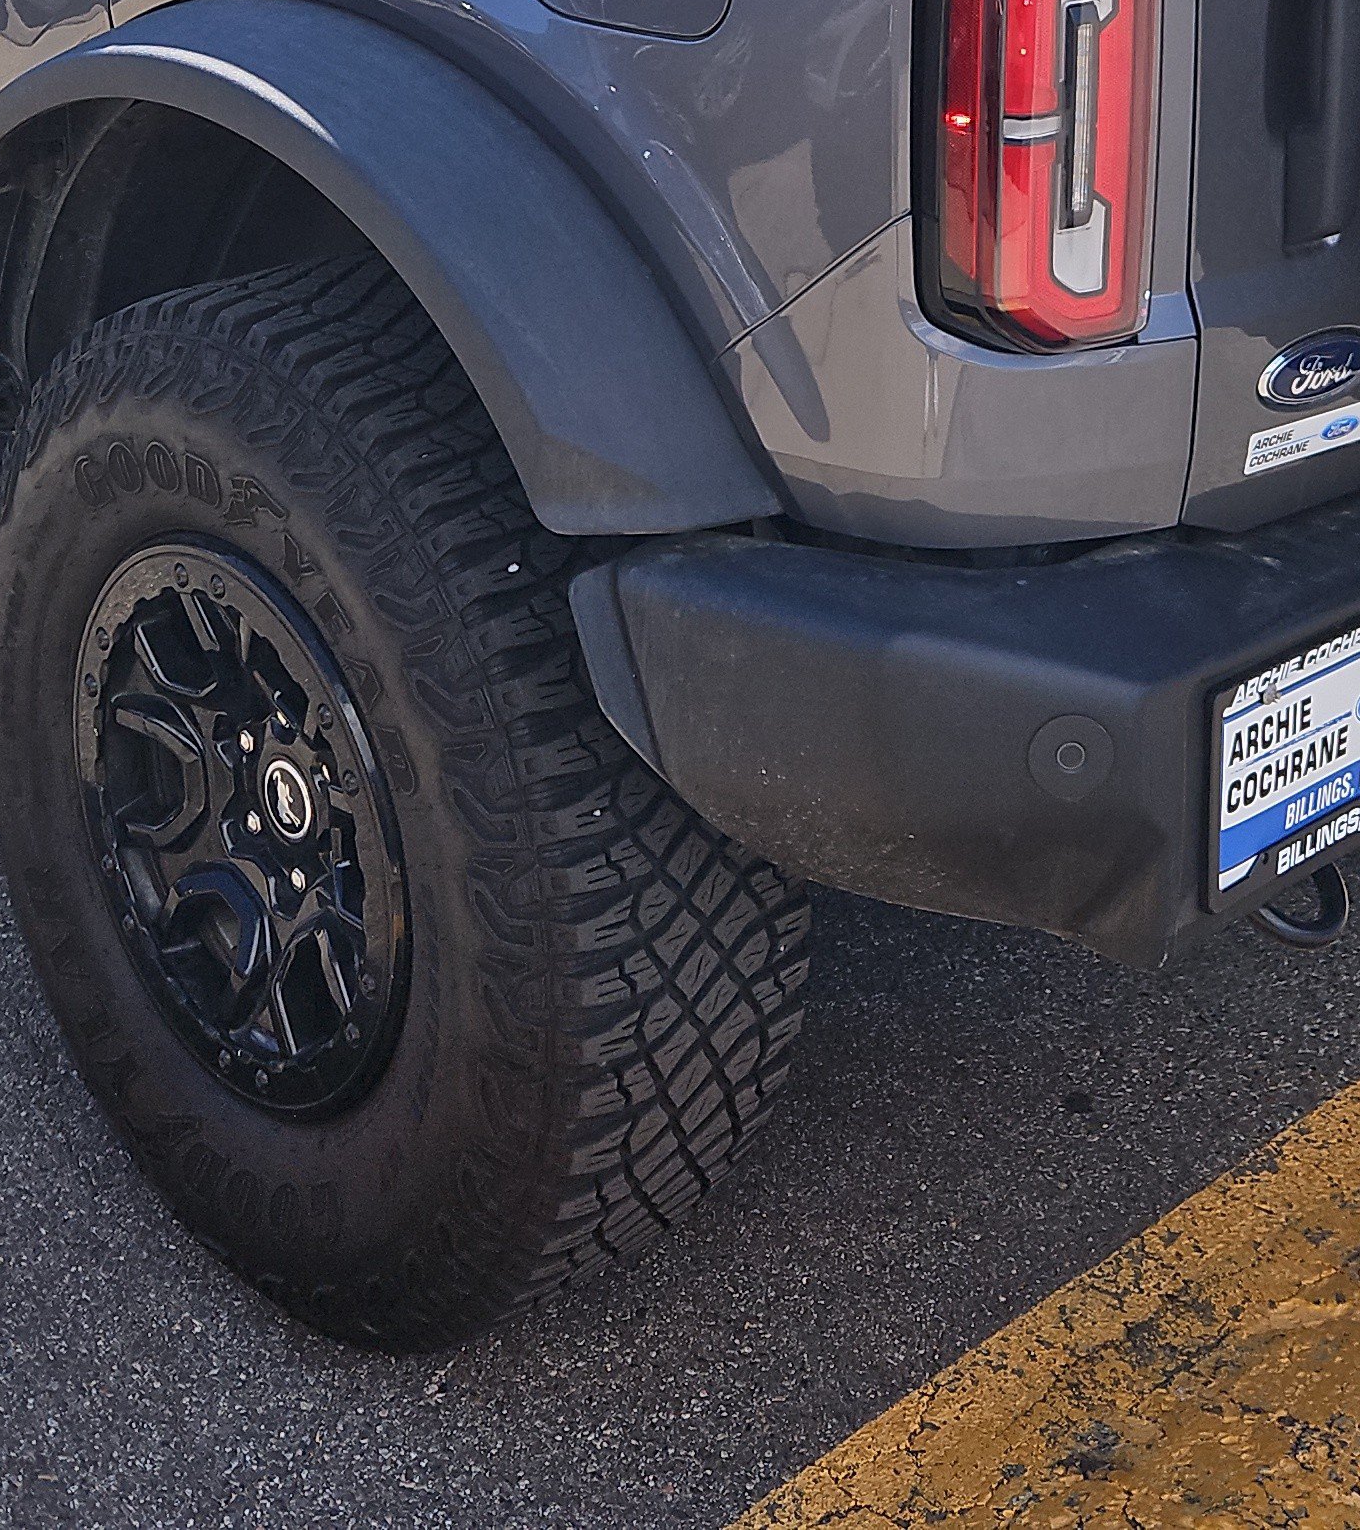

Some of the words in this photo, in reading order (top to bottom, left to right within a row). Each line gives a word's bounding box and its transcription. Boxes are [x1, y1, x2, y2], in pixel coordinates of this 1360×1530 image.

[1291, 352, 1354, 395] Ford
[1248, 440, 1310, 468] COCHRANE
[1252, 429, 1294, 452] ARCHIE
[1232, 655, 1303, 706] ARCHIE
[1228, 696, 1312, 766] ARCHIE
[1226, 724, 1350, 813] COCHRANE
[1284, 771, 1355, 830] BILLINGS,
